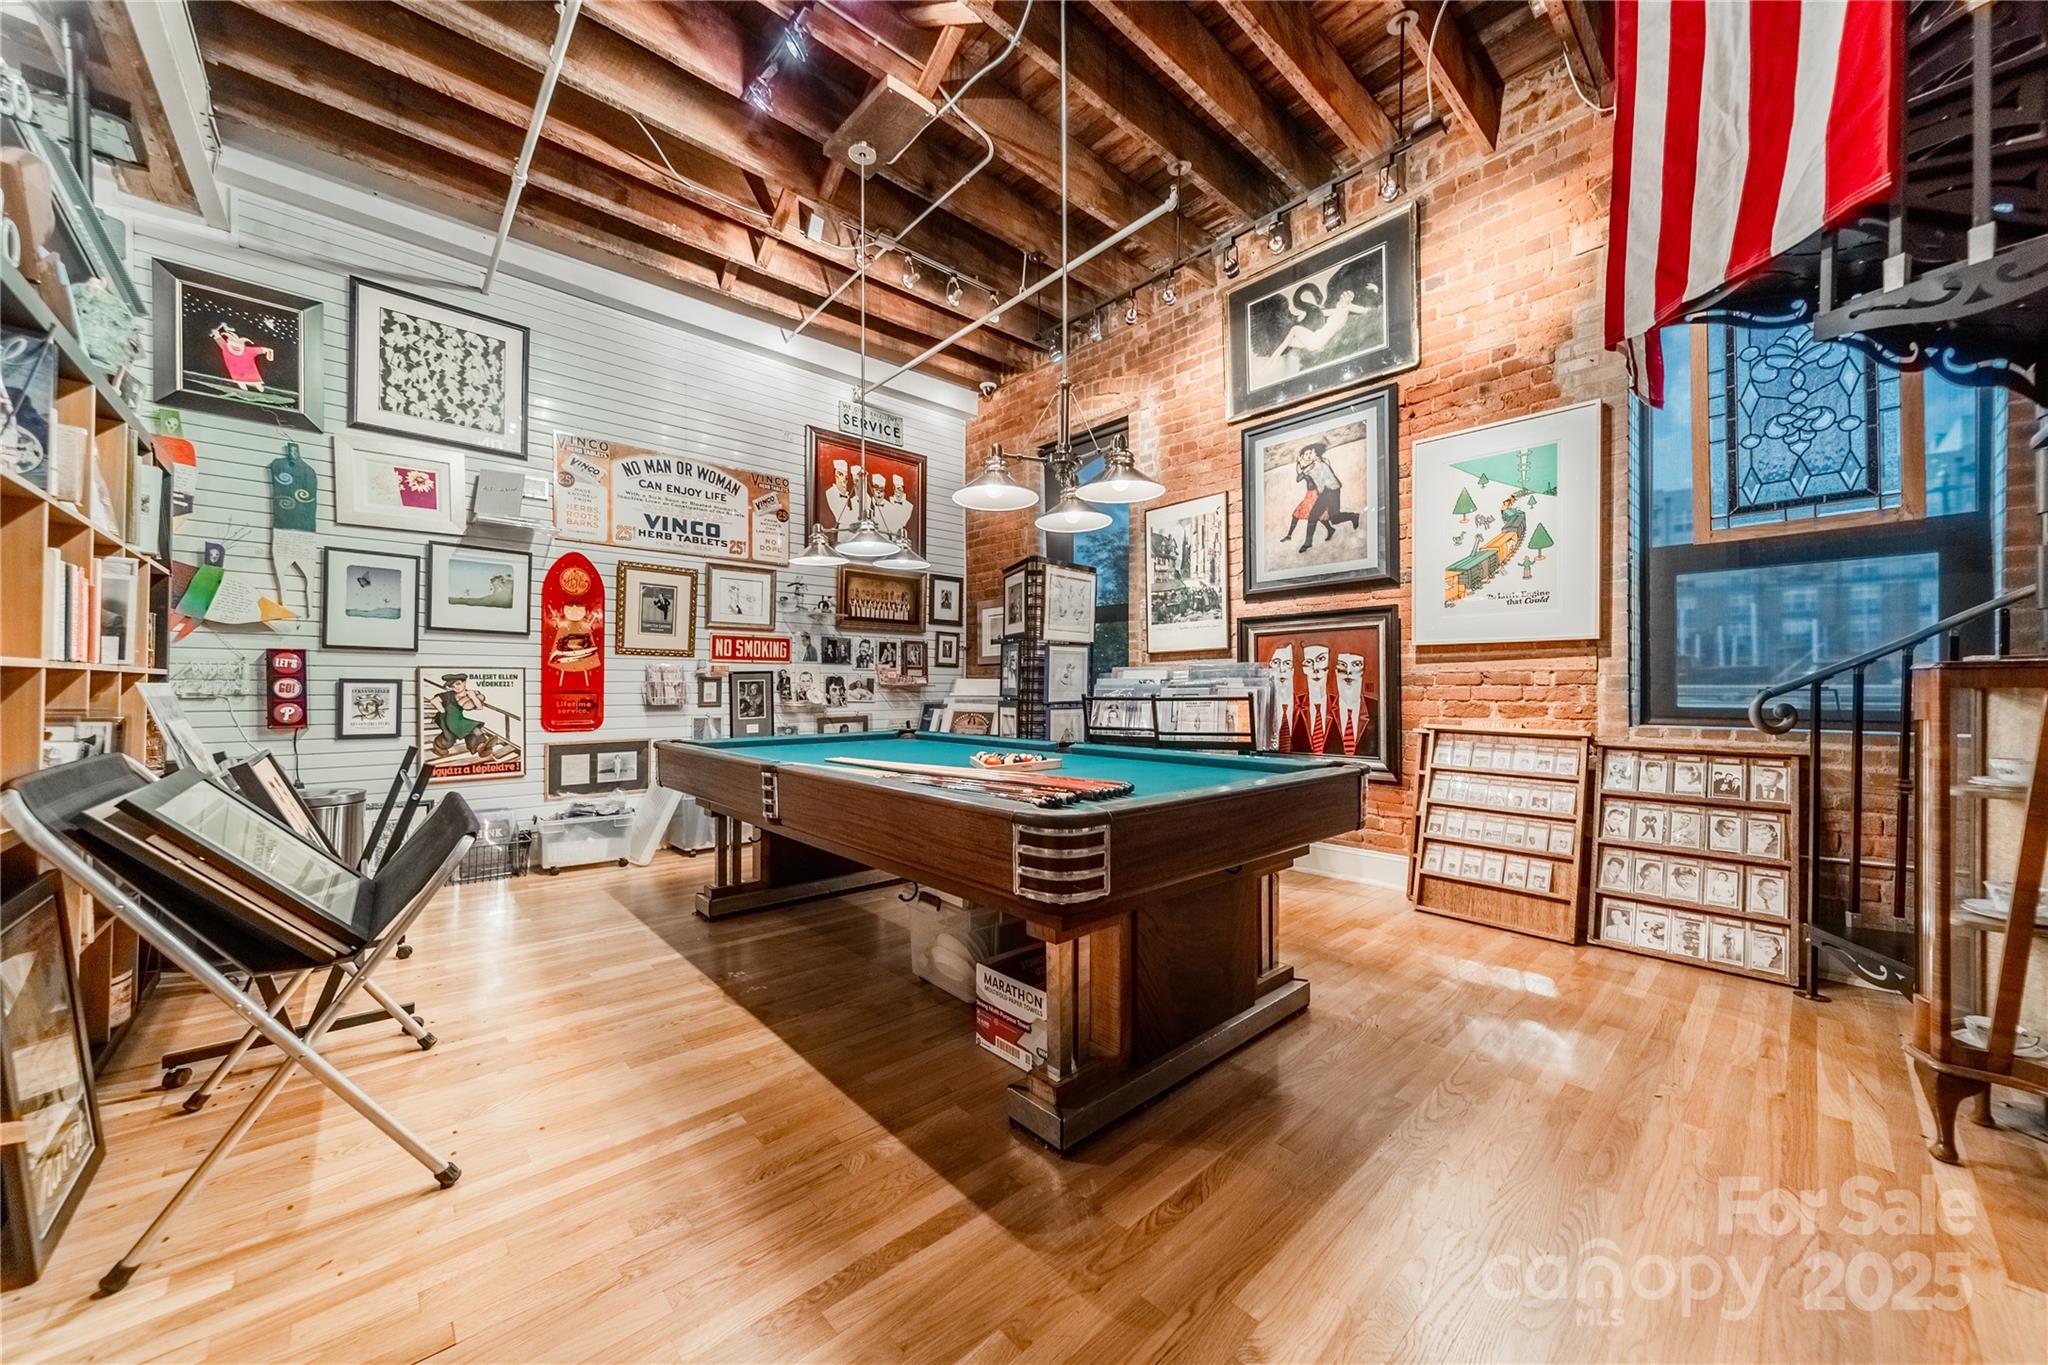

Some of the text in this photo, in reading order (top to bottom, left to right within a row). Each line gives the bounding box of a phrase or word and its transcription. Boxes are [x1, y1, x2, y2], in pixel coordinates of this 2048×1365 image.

[843, 413, 901, 439] SERVICE
[557, 434, 609, 451] VINCO
[570, 457, 600, 475] VINCO
[621, 459, 741, 496] NO MAN OR WOMAN
[751, 472, 790, 487] VINCO
[638, 479, 727, 502] CAN ENJOY LIFE
[566, 503, 599, 514] HERBS
[755, 495, 775, 511] VINCO
[566, 510, 599, 521] ROOTS
[566, 518, 600, 529] BARKS
[643, 513, 721, 538] VINCO
[638, 529, 728, 547] HERB TABLETS
[765, 538, 777, 546] NO
[1524, 595, 1550, 605] Could
[715, 638, 787, 658] NO SMOKING
[275, 658, 298, 669] LET'S
[278, 684, 296, 693] GO!
[432, 766, 462, 776] igyázz
[983, 972, 1043, 1010] MARATHON
[1008, 996, 1023, 1008] PAPER
[1023, 1002, 1043, 1017] TOWELS
